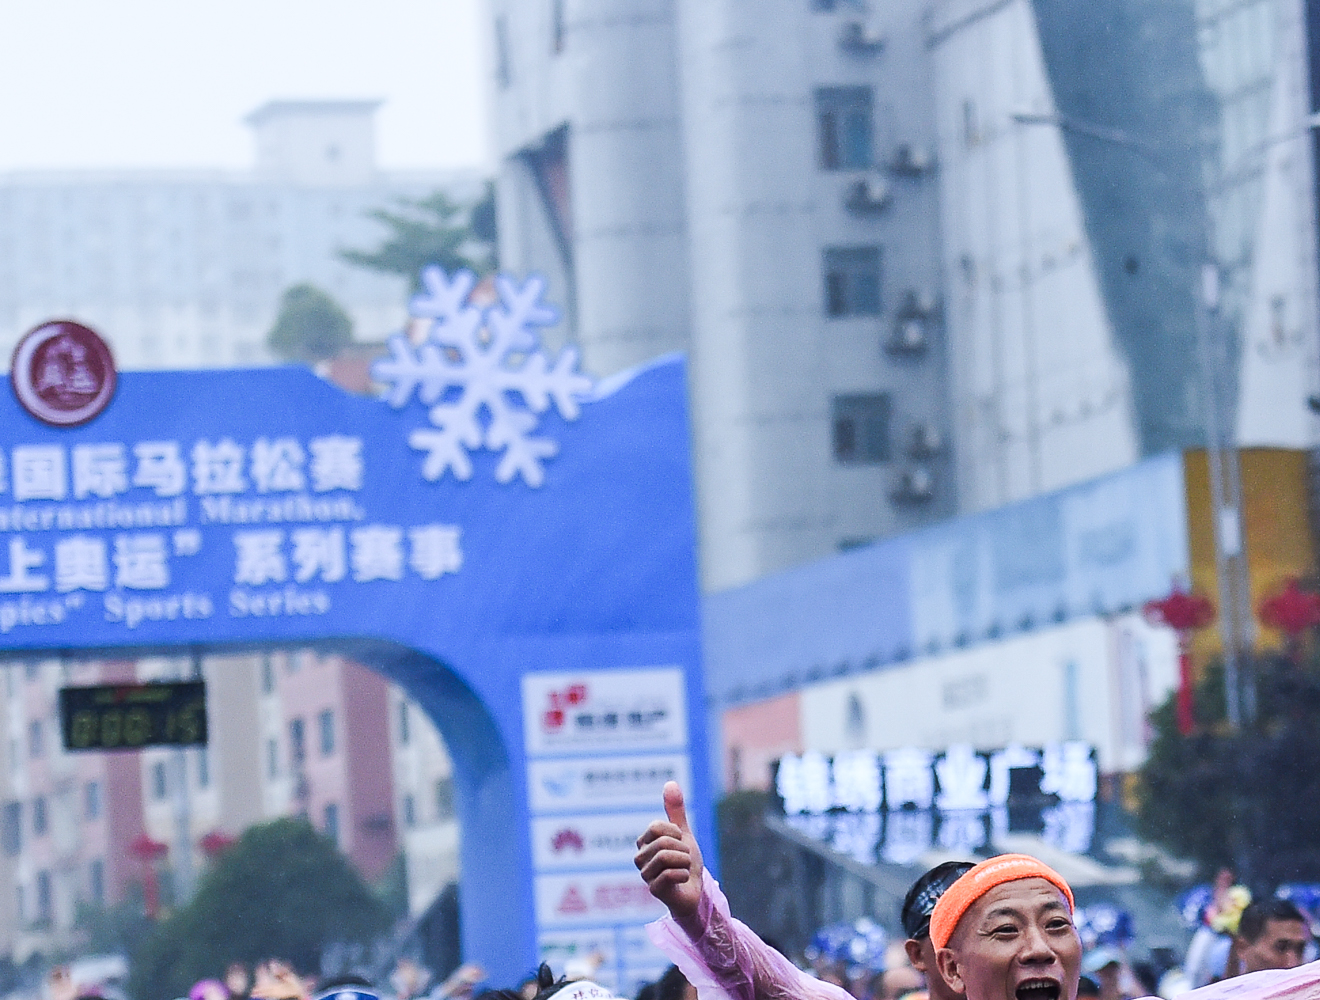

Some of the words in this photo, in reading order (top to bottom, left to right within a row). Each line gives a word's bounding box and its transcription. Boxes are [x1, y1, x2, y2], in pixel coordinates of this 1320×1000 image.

[0, 435, 364, 501] 国际马拉松赛
